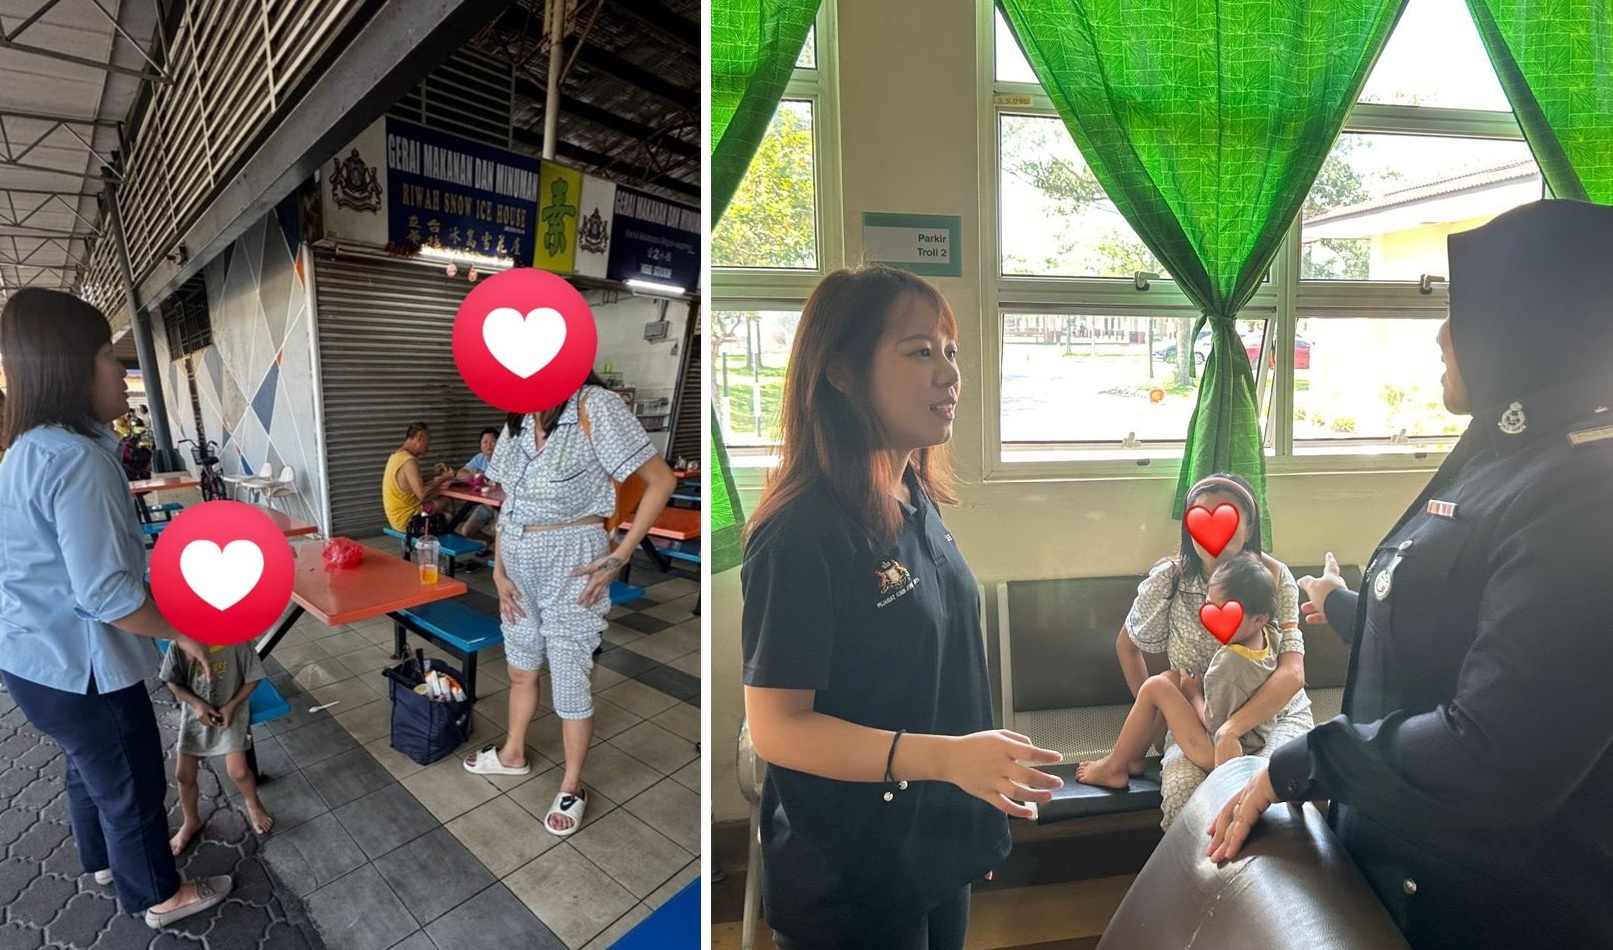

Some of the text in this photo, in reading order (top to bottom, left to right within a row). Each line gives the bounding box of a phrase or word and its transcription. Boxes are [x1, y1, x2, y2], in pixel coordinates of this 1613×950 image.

[388, 133, 539, 203] GERAI MAKANAN DAN MINUMAN
[403, 183, 527, 228] RIWAH SNOW ICE HOUSE
[918, 233, 947, 243] Parkir
[917, 248, 947, 257] Troli 2
